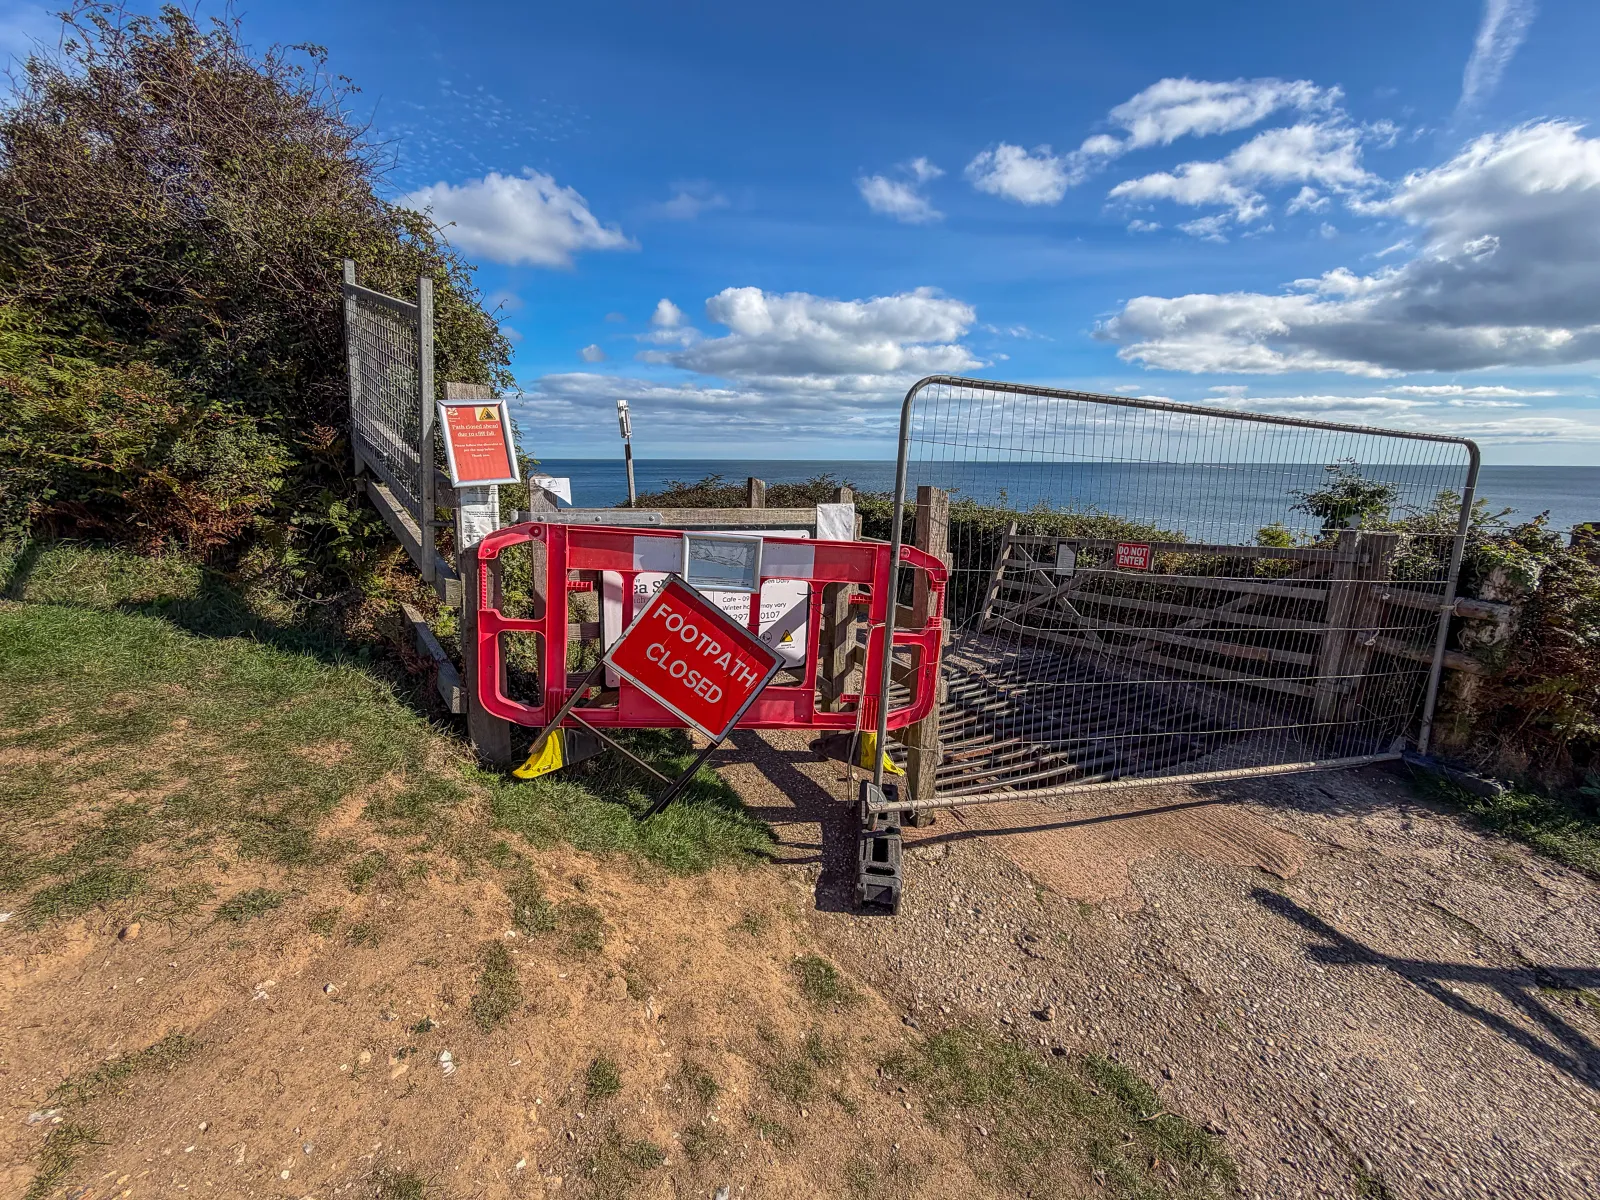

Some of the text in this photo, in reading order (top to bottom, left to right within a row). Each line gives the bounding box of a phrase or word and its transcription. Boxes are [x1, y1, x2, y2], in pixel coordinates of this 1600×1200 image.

[1119, 546, 1147, 556] DO NOT
[1119, 555, 1144, 566] ENTER
[634, 583, 648, 594] ea
[652, 602, 758, 688] FOOTPATH
[646, 642, 723, 704] CLOSED
